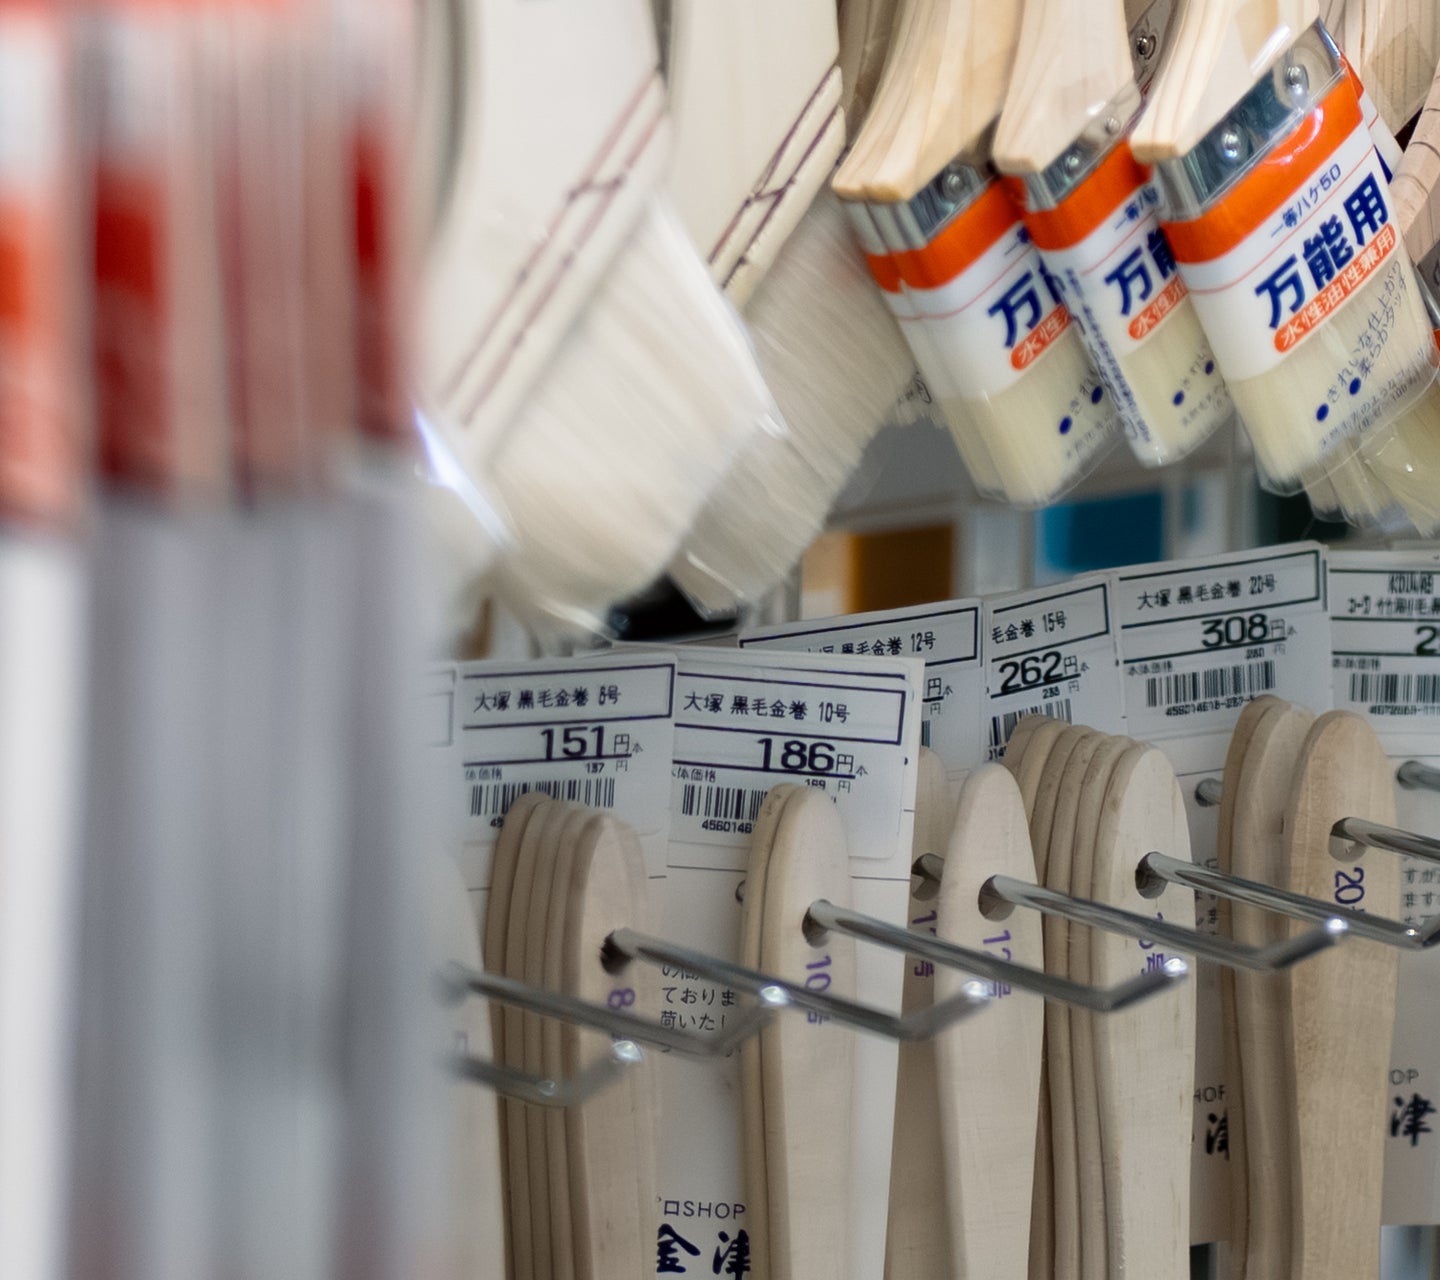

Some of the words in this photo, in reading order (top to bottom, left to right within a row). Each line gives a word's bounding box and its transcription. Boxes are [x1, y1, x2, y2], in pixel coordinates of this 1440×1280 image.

[1270, 162, 1343, 239] 一等ハケ50
[1255, 172, 1392, 330] 万能用
[1279, 226, 1396, 351] 水性油性兼用
[1137, 587, 1171, 610] 大塚
[1042, 609, 1068, 634] 15号
[910, 630, 937, 652] 12号
[474, 692, 511, 713] 大塚
[517, 687, 589, 710] 黒毛金巻
[683, 692, 724, 714] 大塚
[730, 695, 808, 721] 黒毛金巻
[819, 702, 851, 724] 10号
[672, 768, 716, 784] 体価格
[657, 1197, 748, 1220] ロSHOP
